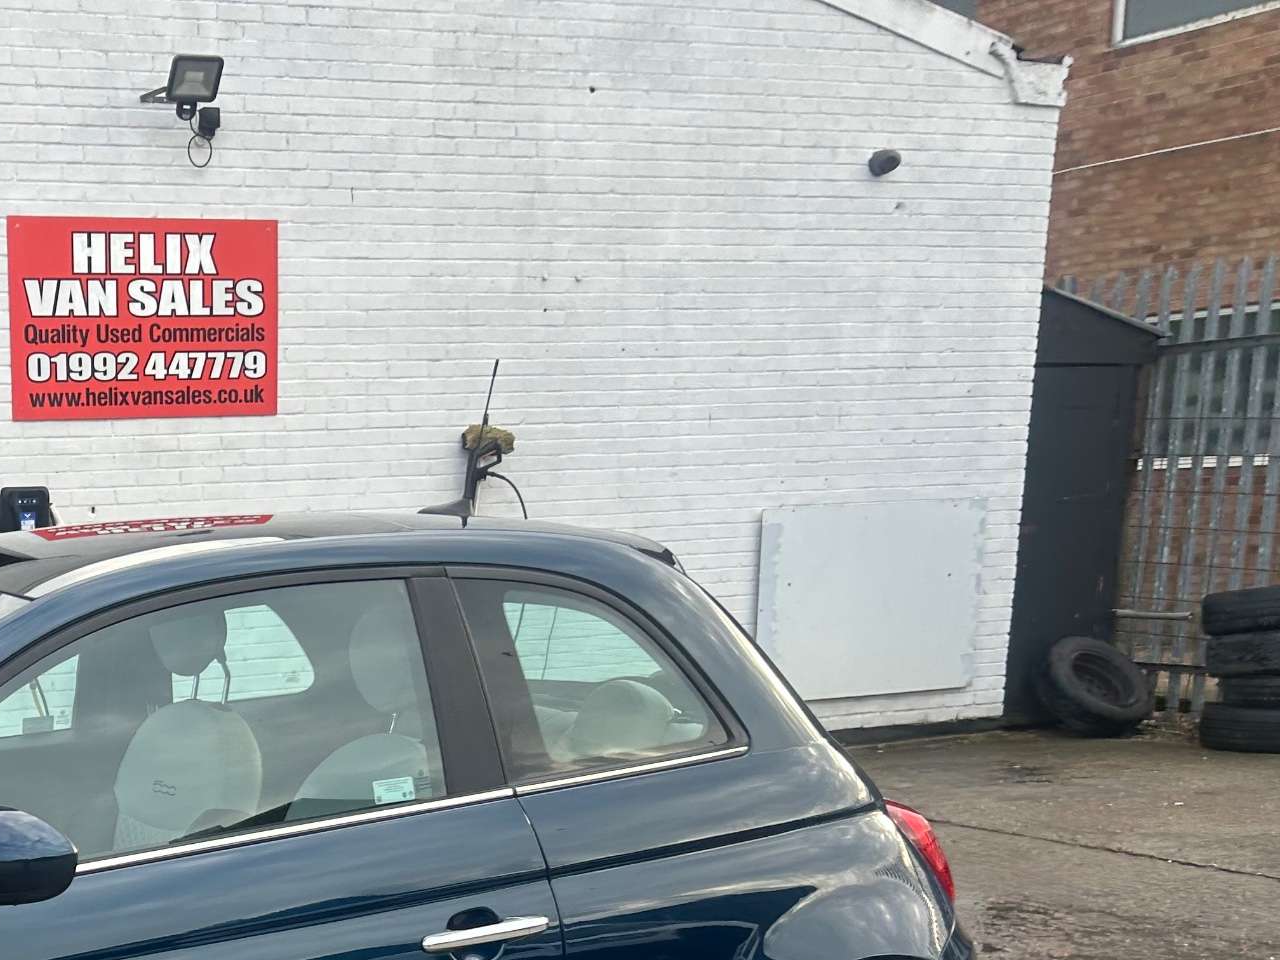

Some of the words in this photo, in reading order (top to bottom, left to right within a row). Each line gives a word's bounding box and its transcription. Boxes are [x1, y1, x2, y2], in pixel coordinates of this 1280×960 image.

[71, 231, 218, 275] HELIX
[23, 278, 119, 318] VAN
[126, 278, 265, 317] SALES
[24, 323, 90, 347] Quality
[96, 323, 143, 344] Used
[149, 322, 265, 343] Commercials
[26, 351, 140, 382] 01992
[143, 350, 267, 380] 447779
[29, 384, 265, 408] www.helixvansales.co.uk
